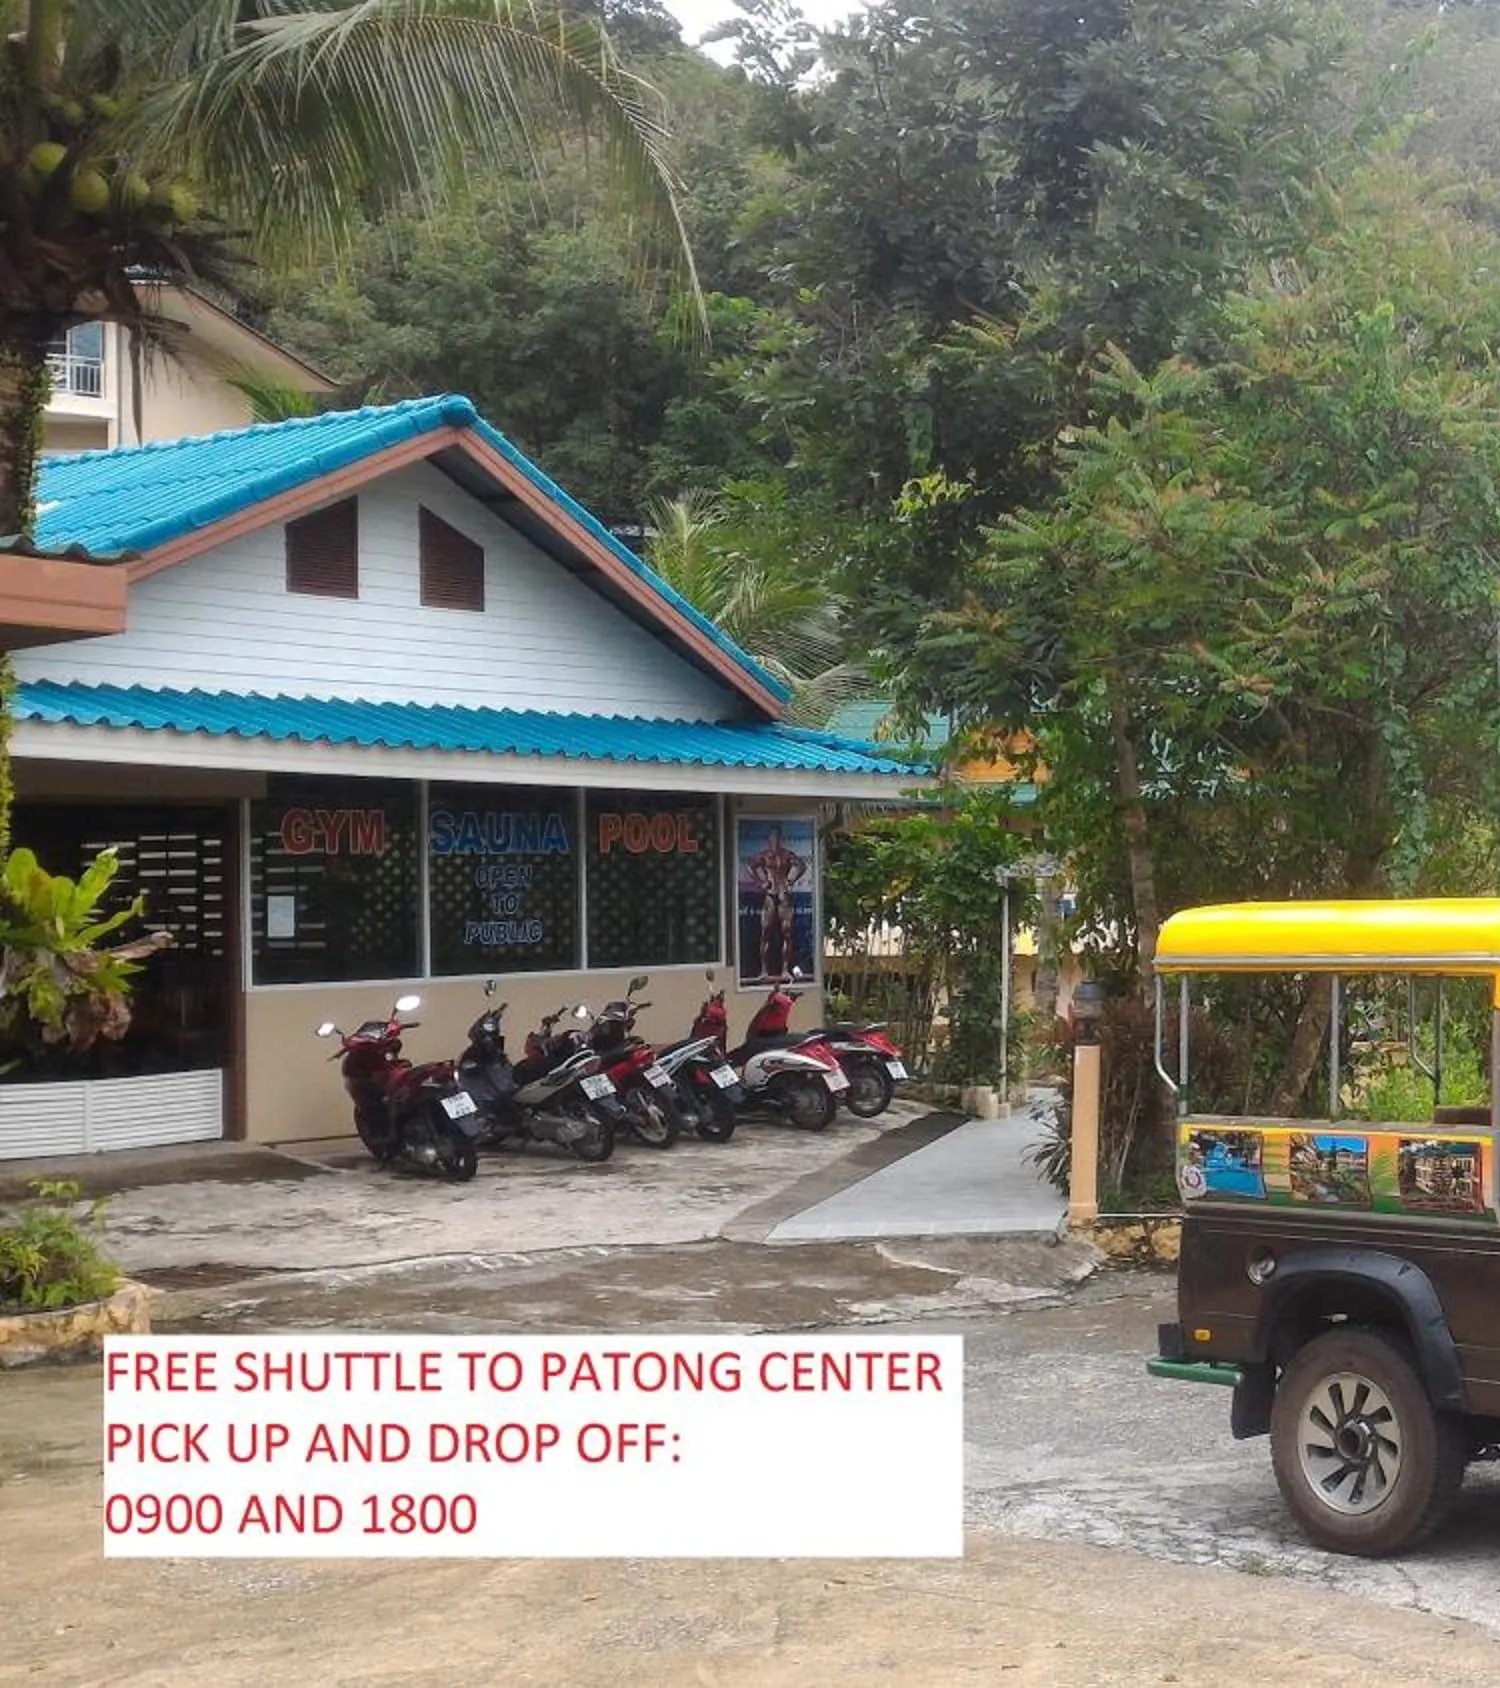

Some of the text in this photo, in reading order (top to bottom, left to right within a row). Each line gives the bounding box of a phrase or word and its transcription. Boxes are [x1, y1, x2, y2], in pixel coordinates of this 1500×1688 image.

[280, 808, 700, 855] GYM SAUNA POOL
[474, 862, 534, 889] OPEN
[491, 893, 520, 915] TO
[463, 919, 544, 945] PUBLIC
